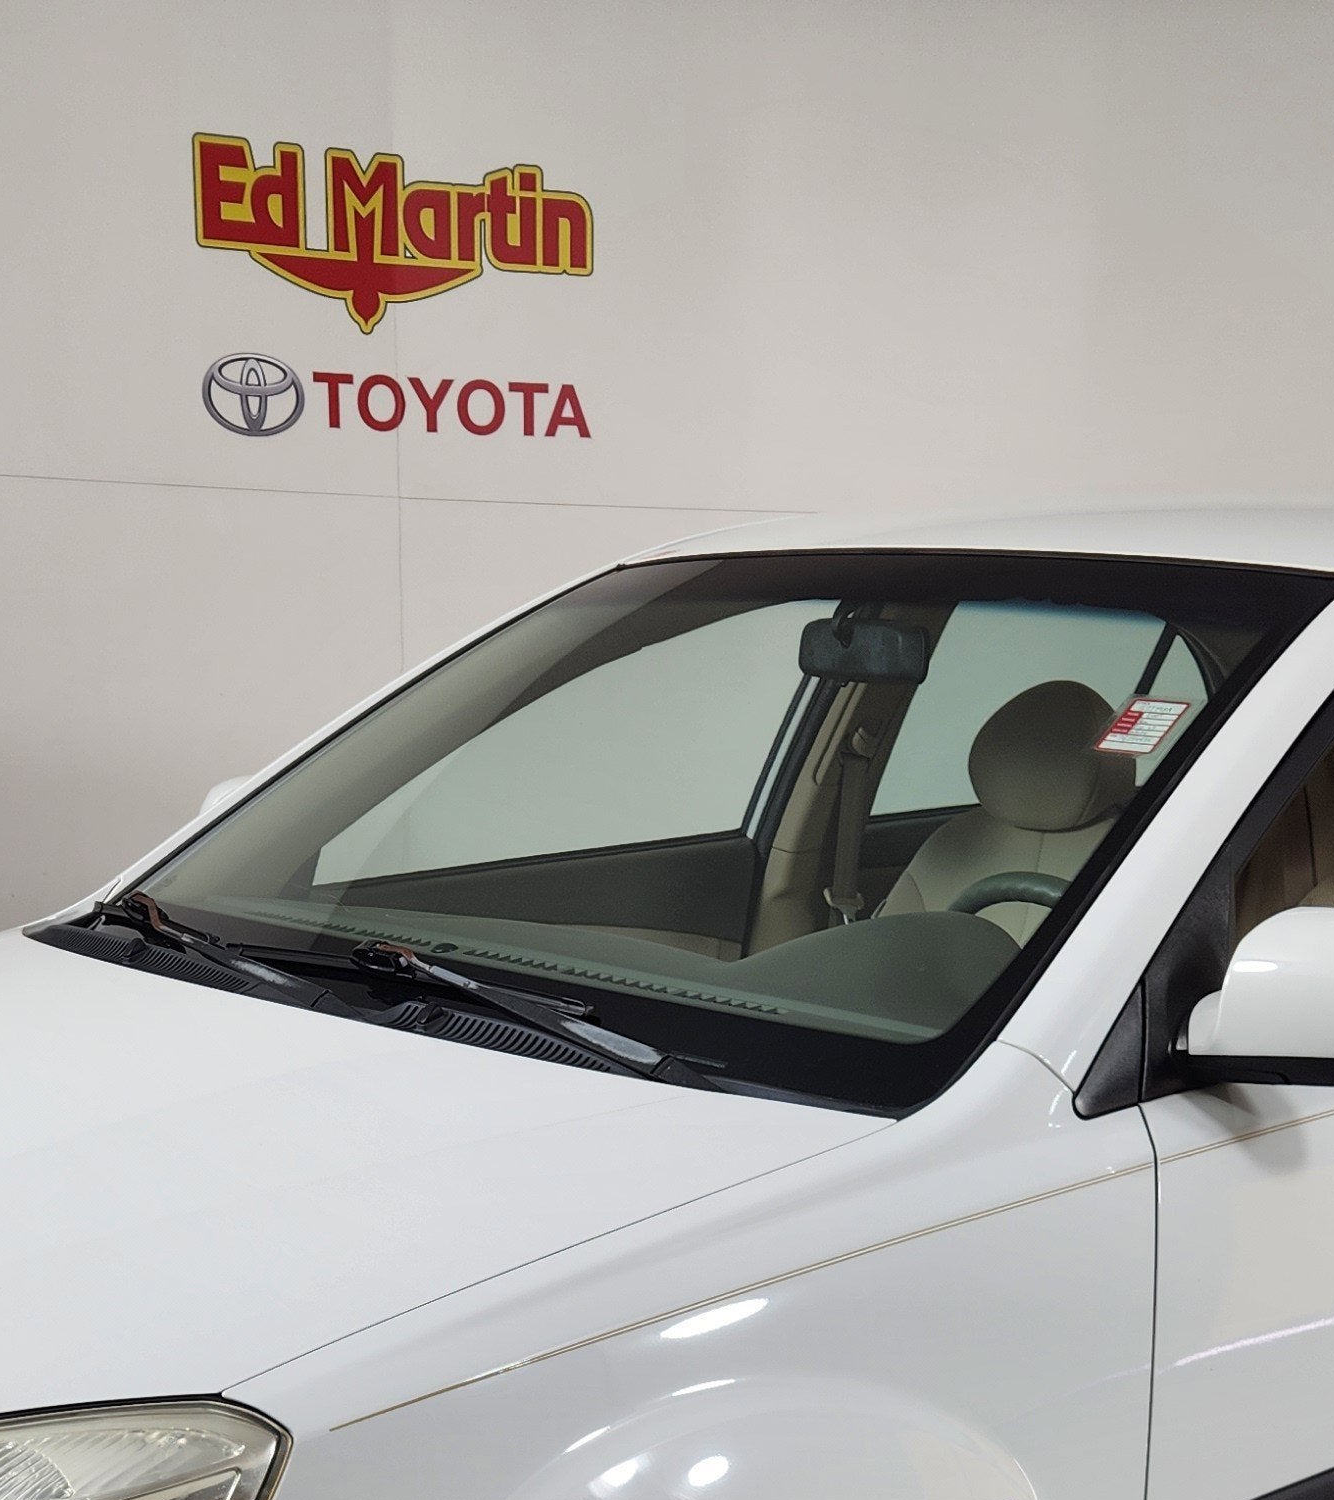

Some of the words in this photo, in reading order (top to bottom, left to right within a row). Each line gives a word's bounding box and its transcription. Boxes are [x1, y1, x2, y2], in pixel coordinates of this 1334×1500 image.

[195, 137, 303, 249] Ed
[327, 149, 591, 272] Martin
[312, 371, 592, 439] TOYOTA
